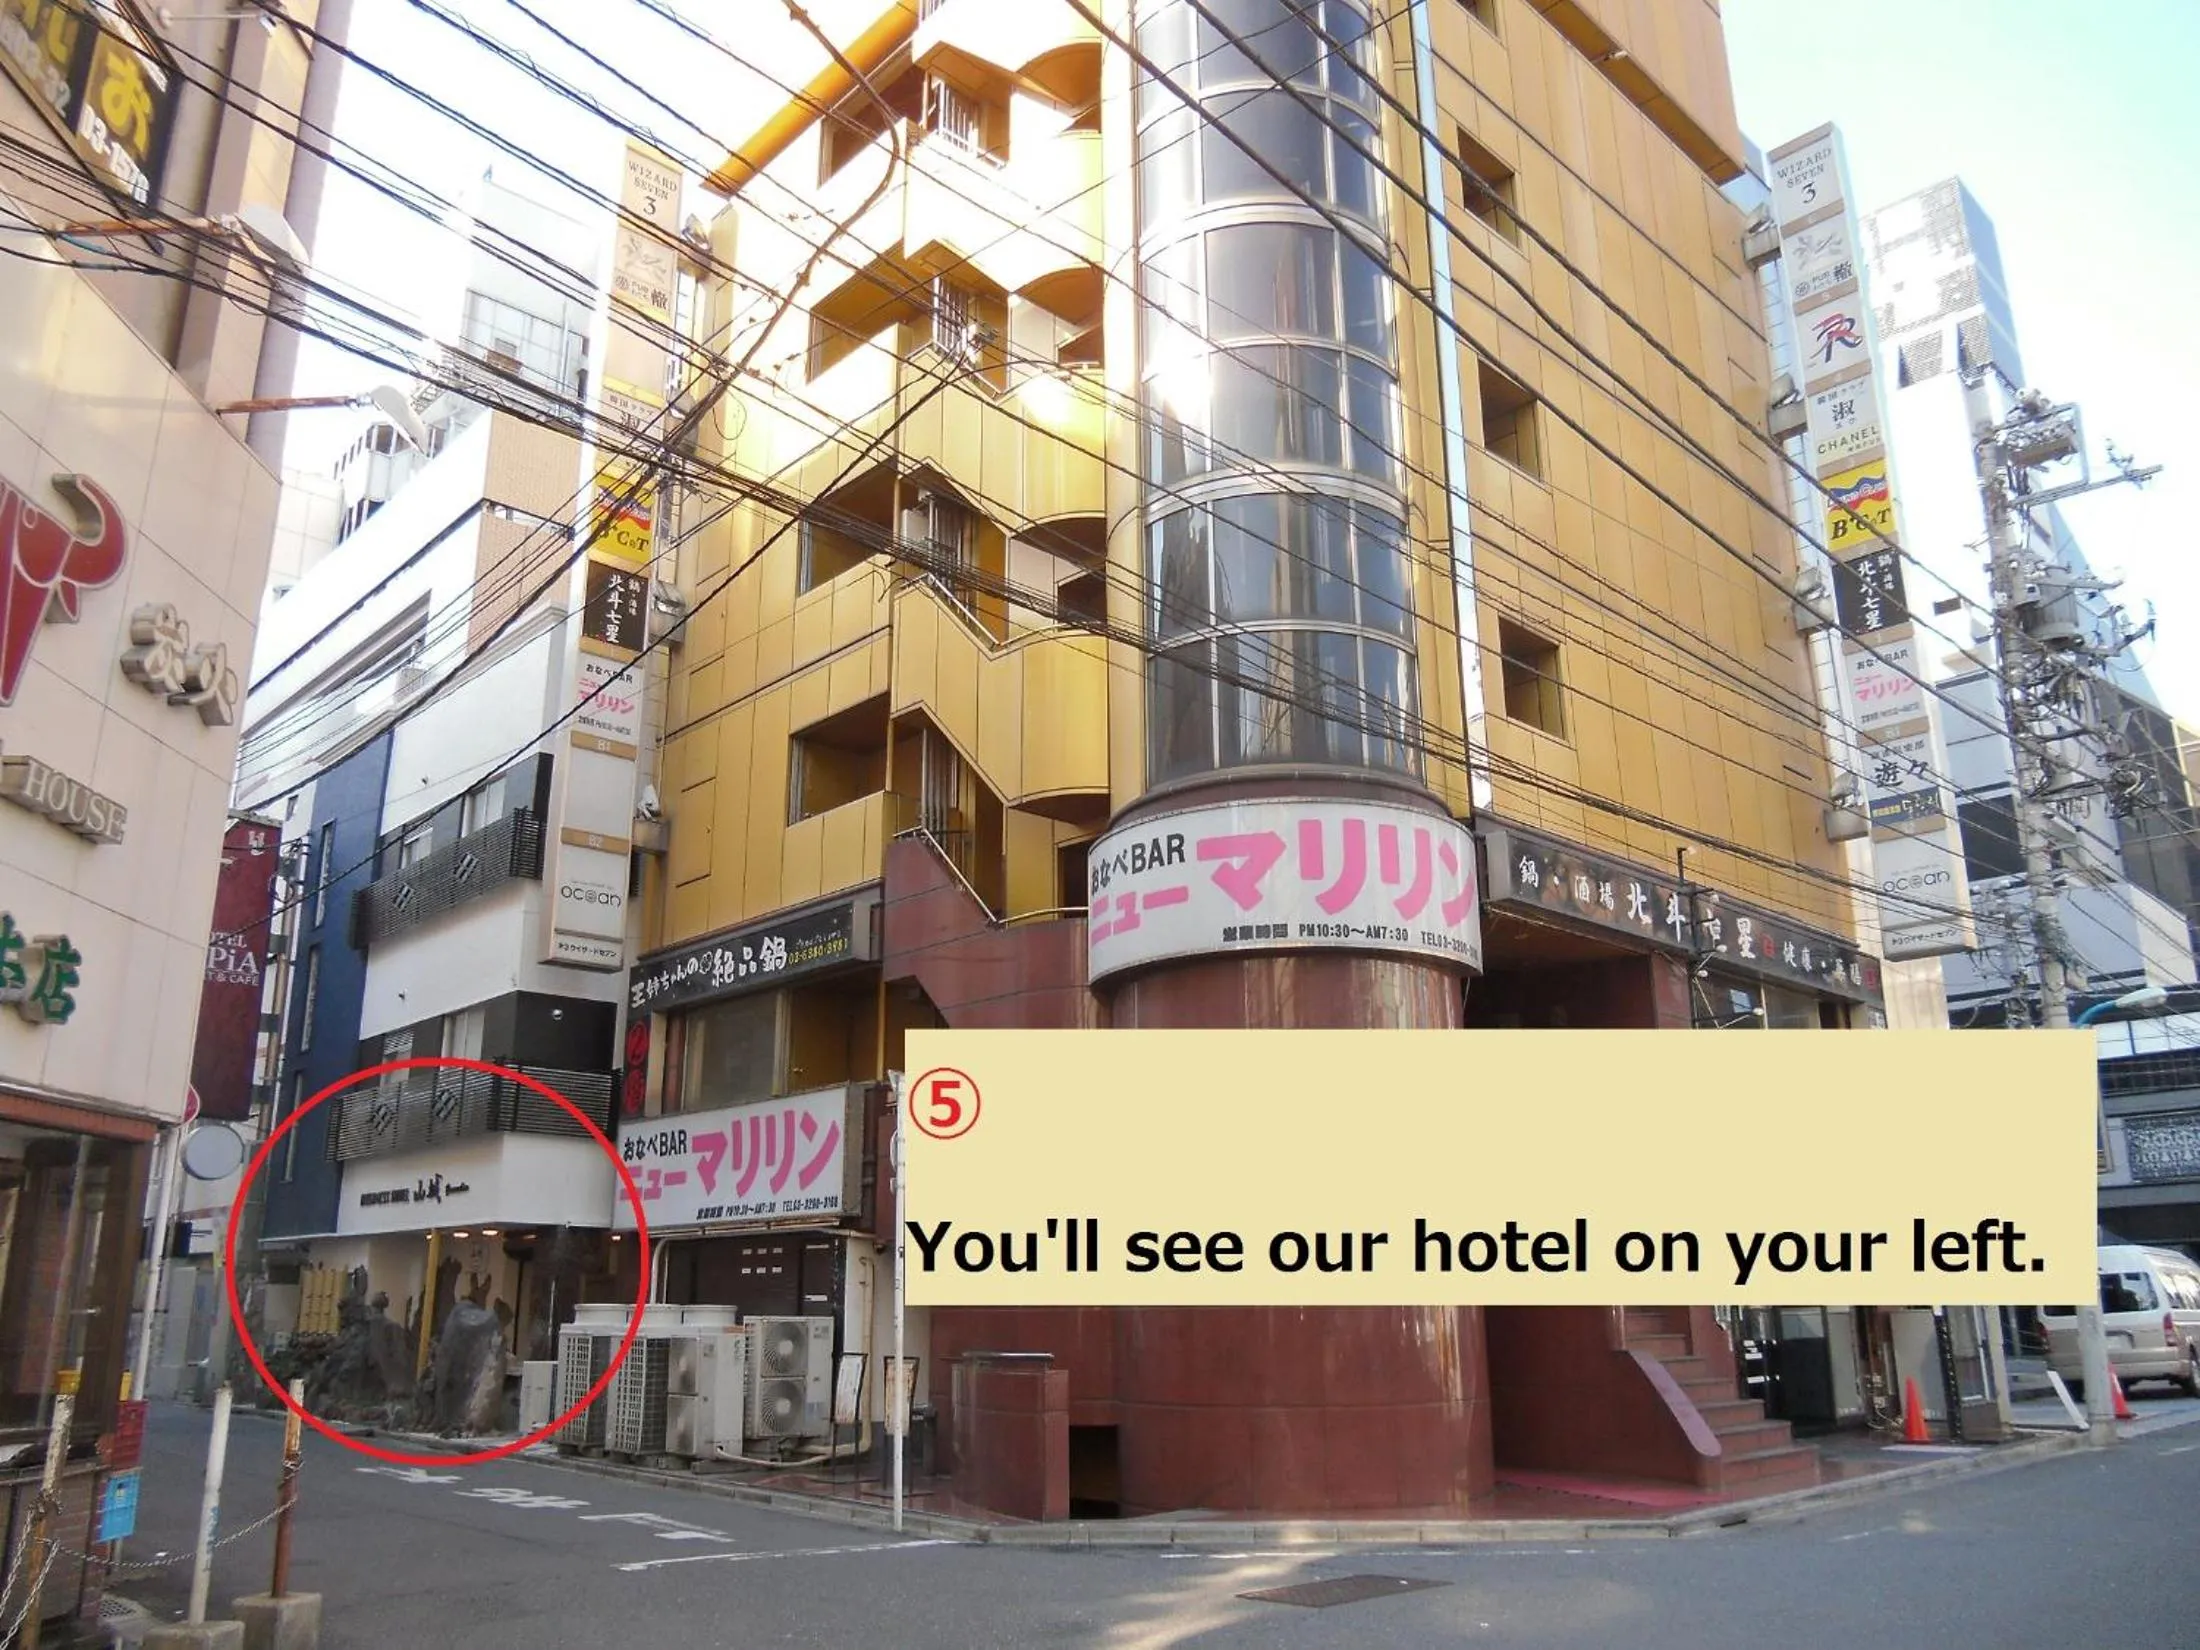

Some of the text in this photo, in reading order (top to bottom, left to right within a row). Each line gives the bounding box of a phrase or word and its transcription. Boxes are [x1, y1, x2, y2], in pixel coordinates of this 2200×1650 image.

[102, 52, 153, 152] お
[628, 160, 678, 192] WIZARD
[1777, 148, 1832, 179] WIZARD
[643, 196, 656, 215] 3
[1801, 181, 1817, 204] 3
[1818, 426, 1878, 454] CHANEL
[606, 574, 626, 644] 北斗七星
[23, 764, 127, 839] HOUSE
[1091, 832, 1186, 897] おなべBAR
[1195, 818, 1477, 928] マリリン
[1519, 855, 1615, 911] 鍋・酒場
[1090, 885, 1189, 947] ニュー
[624, 1129, 687, 1162] おなべBAR
[691, 1109, 840, 1199] マリリン
[619, 1164, 688, 1201] ニュー
